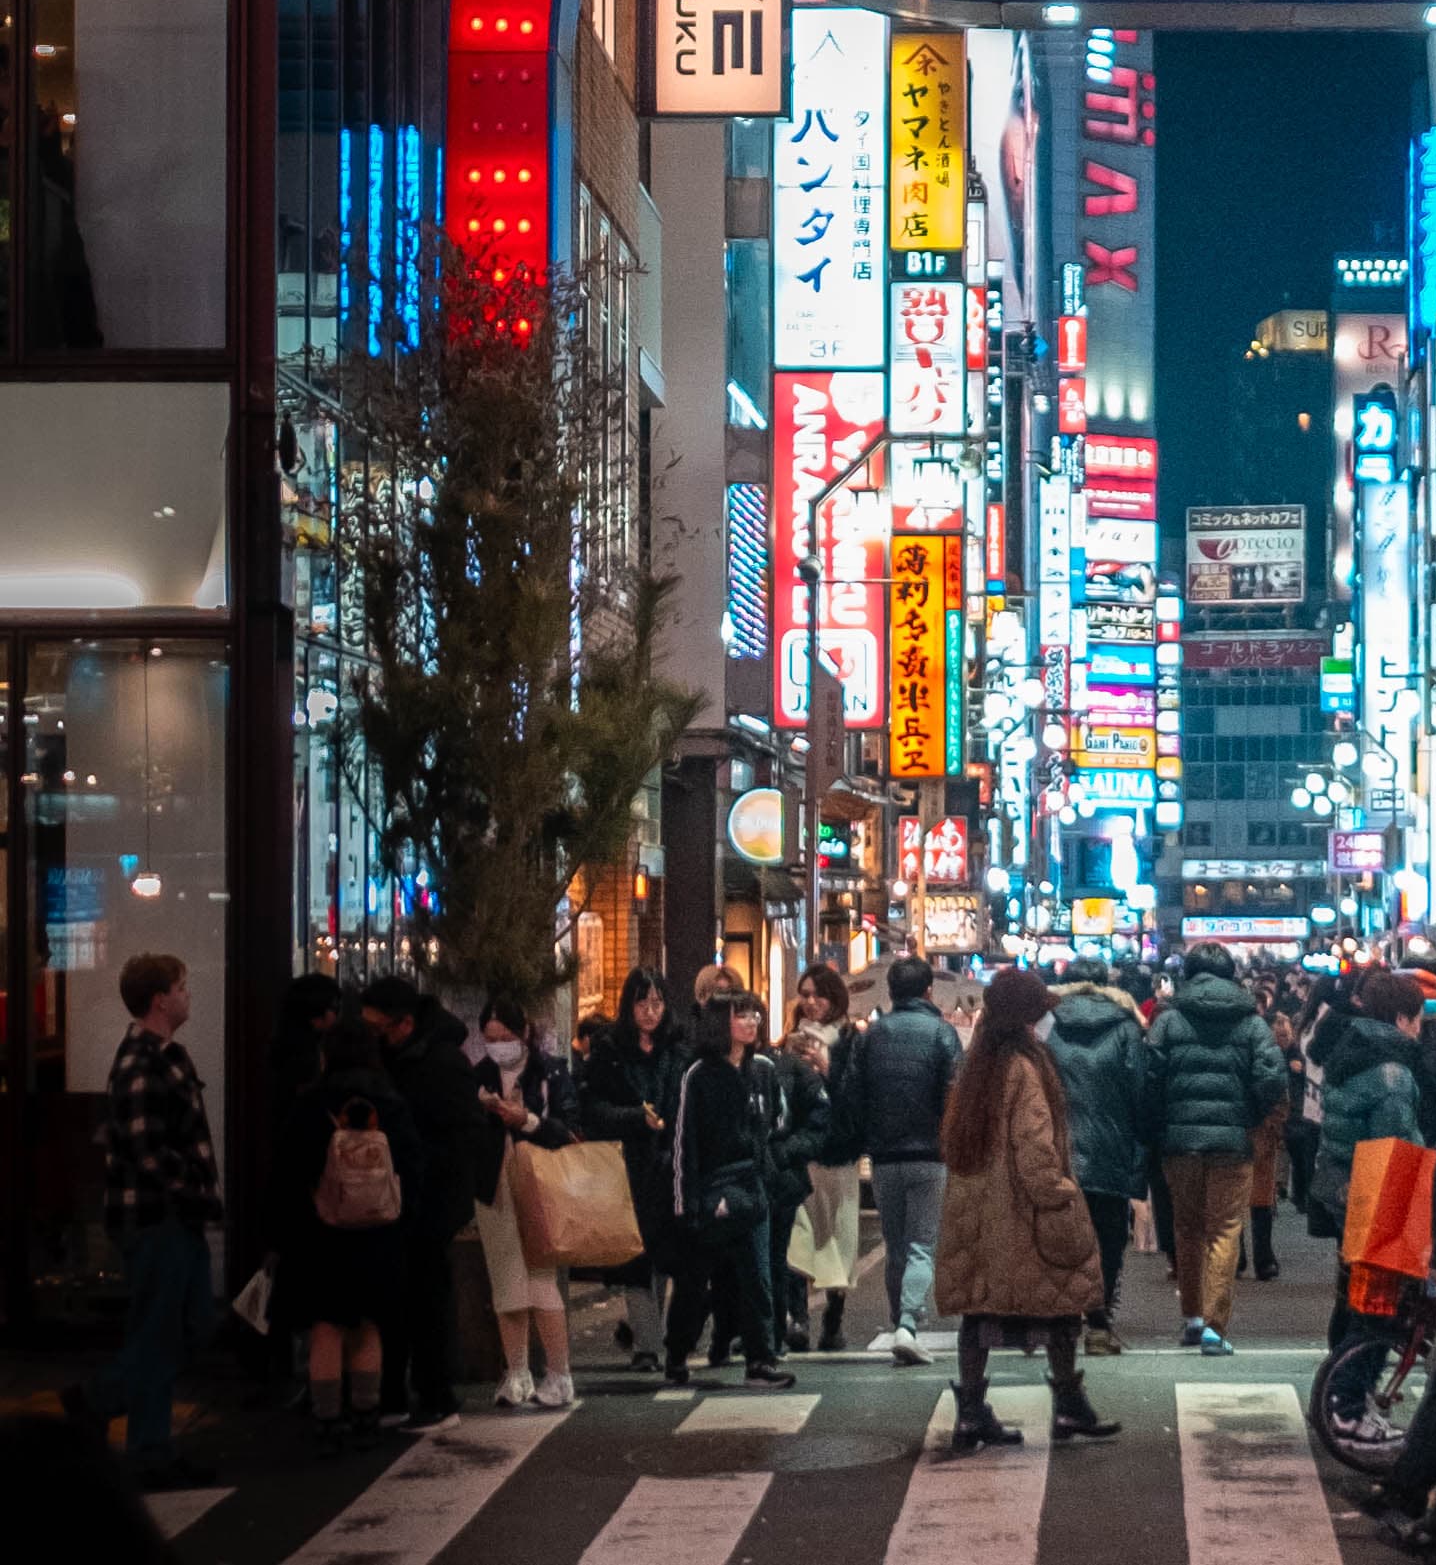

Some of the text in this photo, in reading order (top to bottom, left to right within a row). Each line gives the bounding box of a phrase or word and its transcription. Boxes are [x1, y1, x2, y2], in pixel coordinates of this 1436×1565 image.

[900, 83, 930, 238] ヤマネ肉店
[905, 251, 947, 275] B1F
